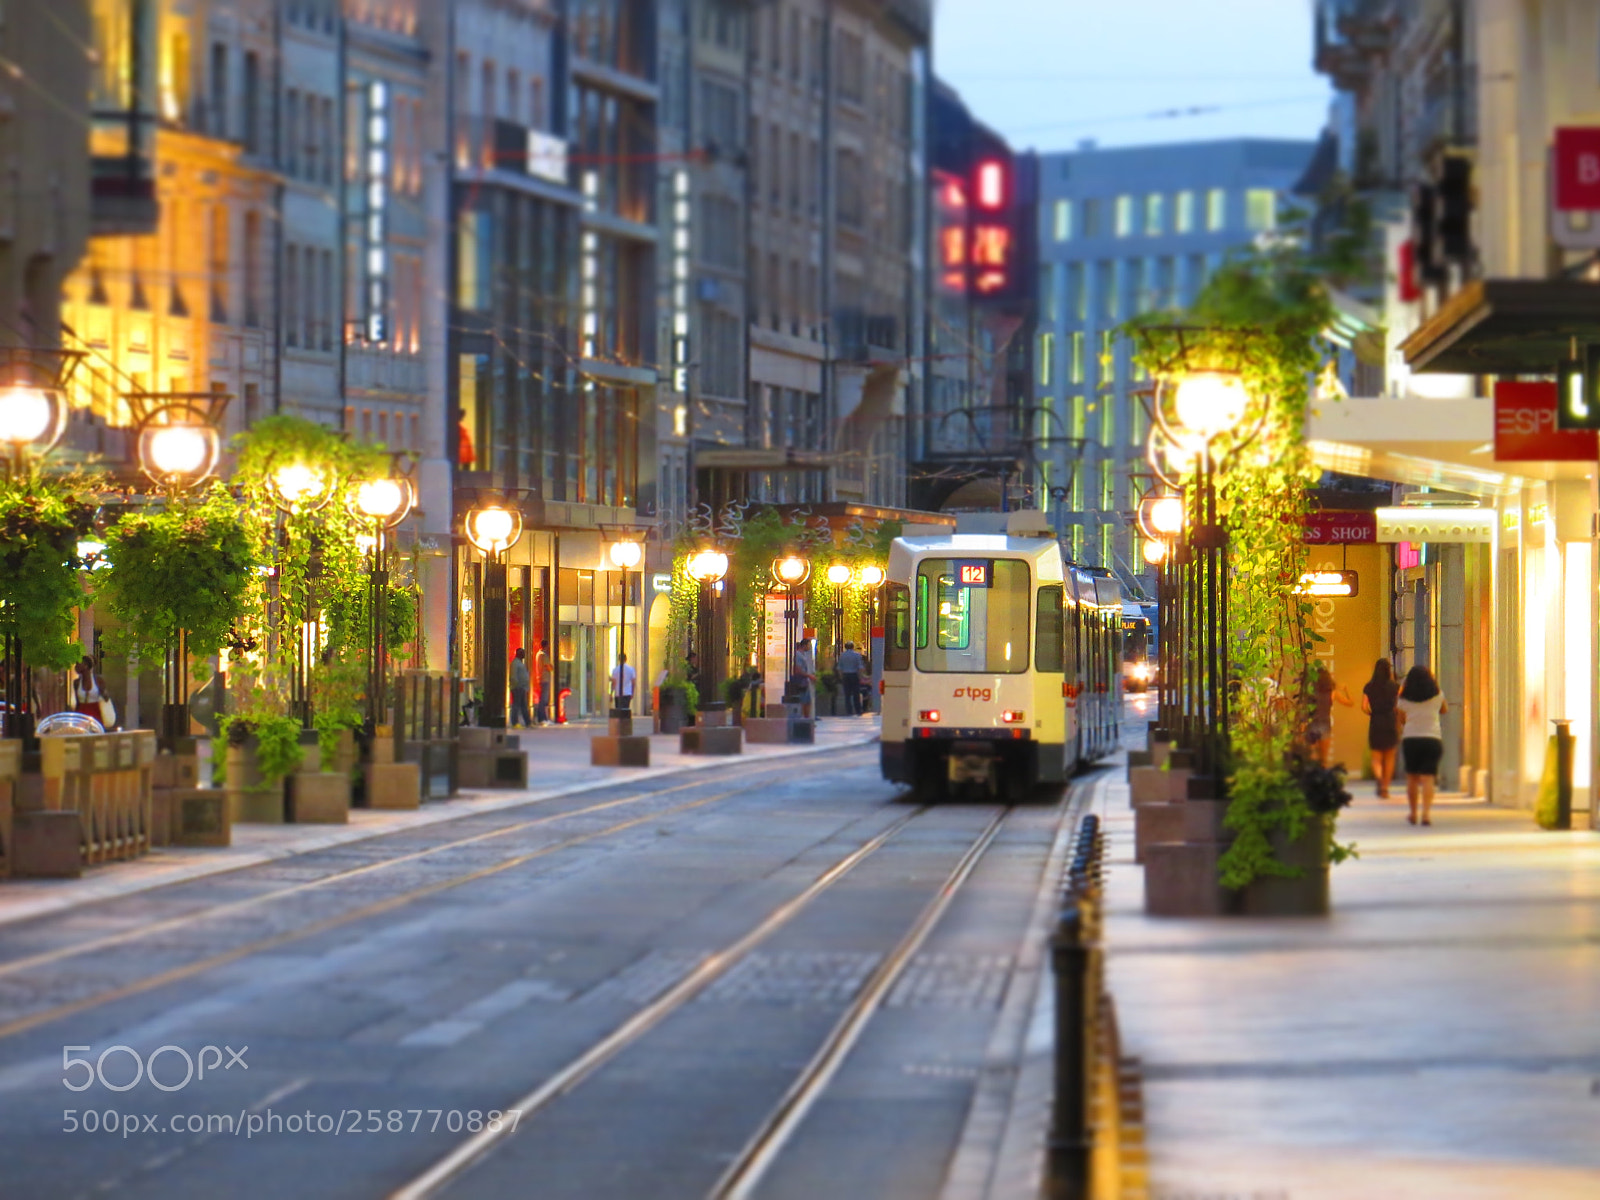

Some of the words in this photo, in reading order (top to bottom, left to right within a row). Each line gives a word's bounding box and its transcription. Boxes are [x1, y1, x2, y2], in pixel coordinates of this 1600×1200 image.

[1498, 408, 1559, 434] ESP
[1331, 526, 1372, 539] SHOP
[1381, 526, 1431, 535] ZARA
[1438, 526, 1490, 535] HOME
[962, 566, 985, 583] 12
[967, 686, 992, 701] tpg
